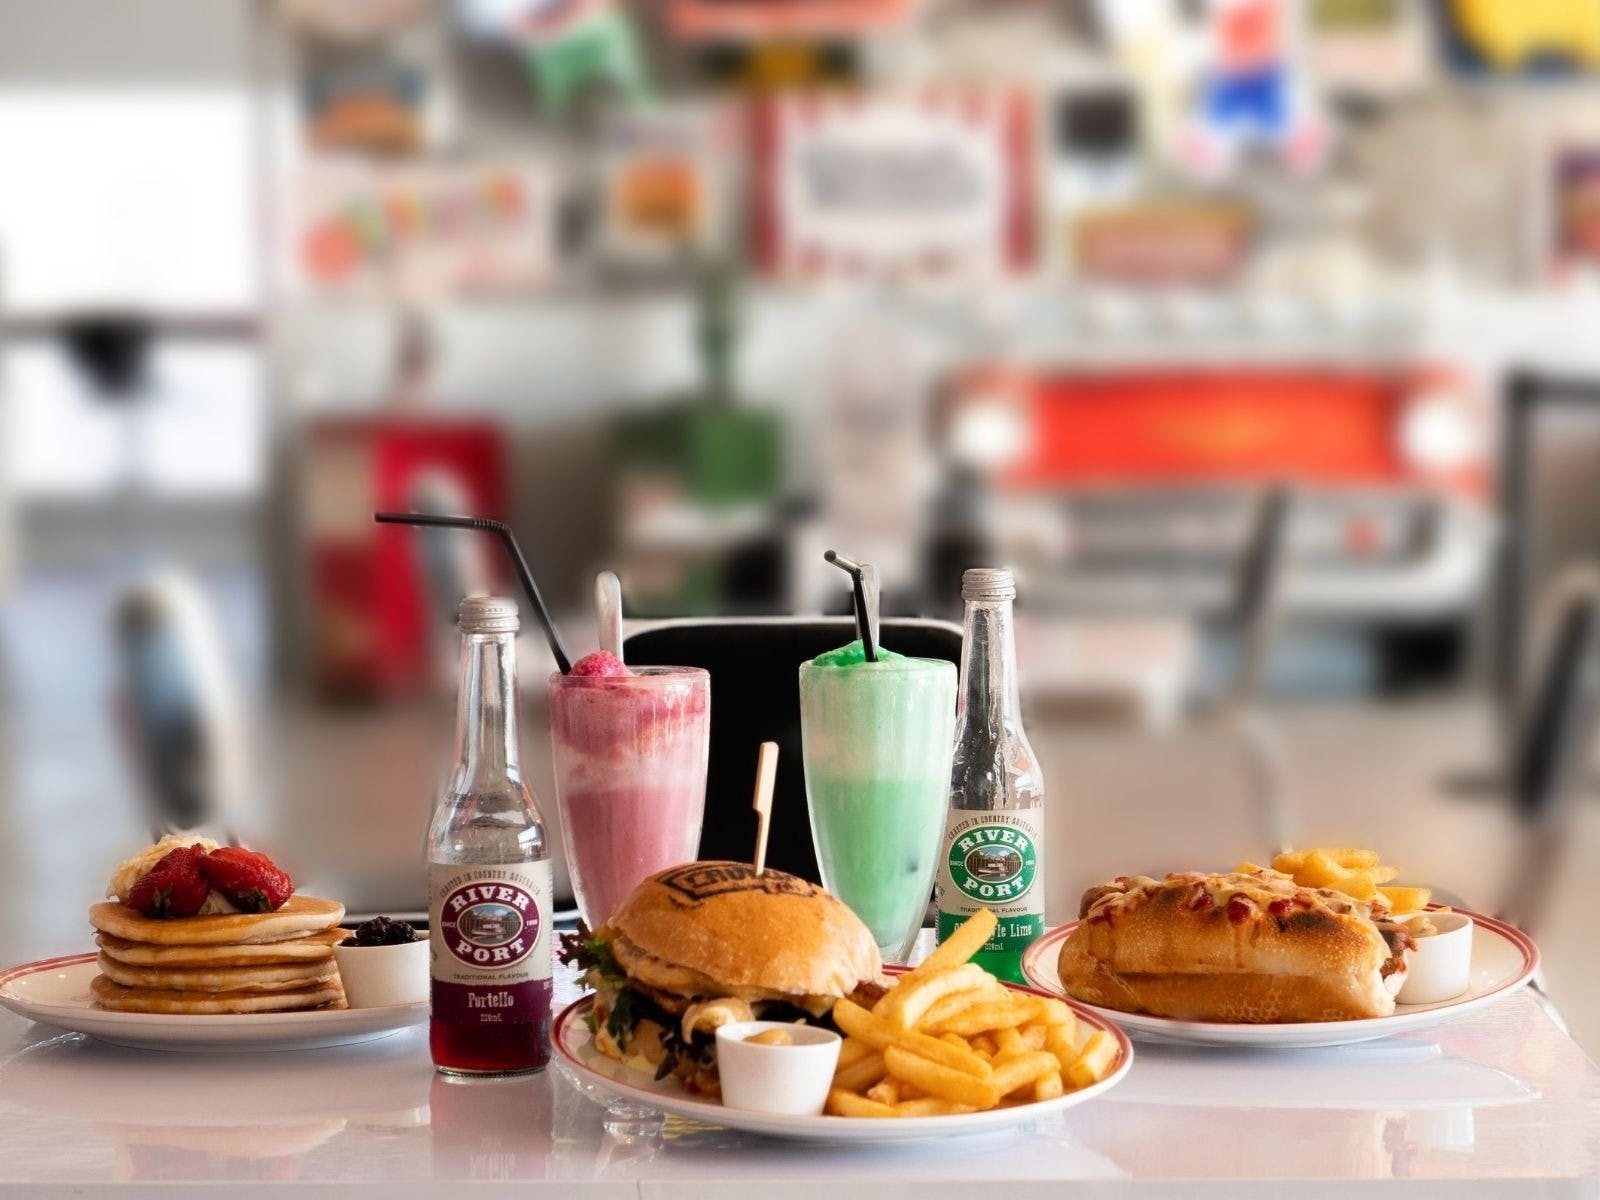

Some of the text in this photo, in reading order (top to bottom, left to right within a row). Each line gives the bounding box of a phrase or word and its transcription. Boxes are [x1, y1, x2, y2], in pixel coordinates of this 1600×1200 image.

[948, 820, 969, 840] CRAFTED
[980, 815, 1010, 823] COUNTRY
[958, 829, 1029, 852] RIVER
[463, 873, 472, 881] IN
[473, 870, 507, 880] COUNTRY
[962, 876, 1025, 897] PORT
[450, 885, 530, 912] RIVER
[1010, 923, 1032, 938] Lime
[456, 938, 525, 961] PORT
[453, 972, 529, 981] TRADITIONAL FLAVOUR
[467, 991, 514, 1009] Portello
